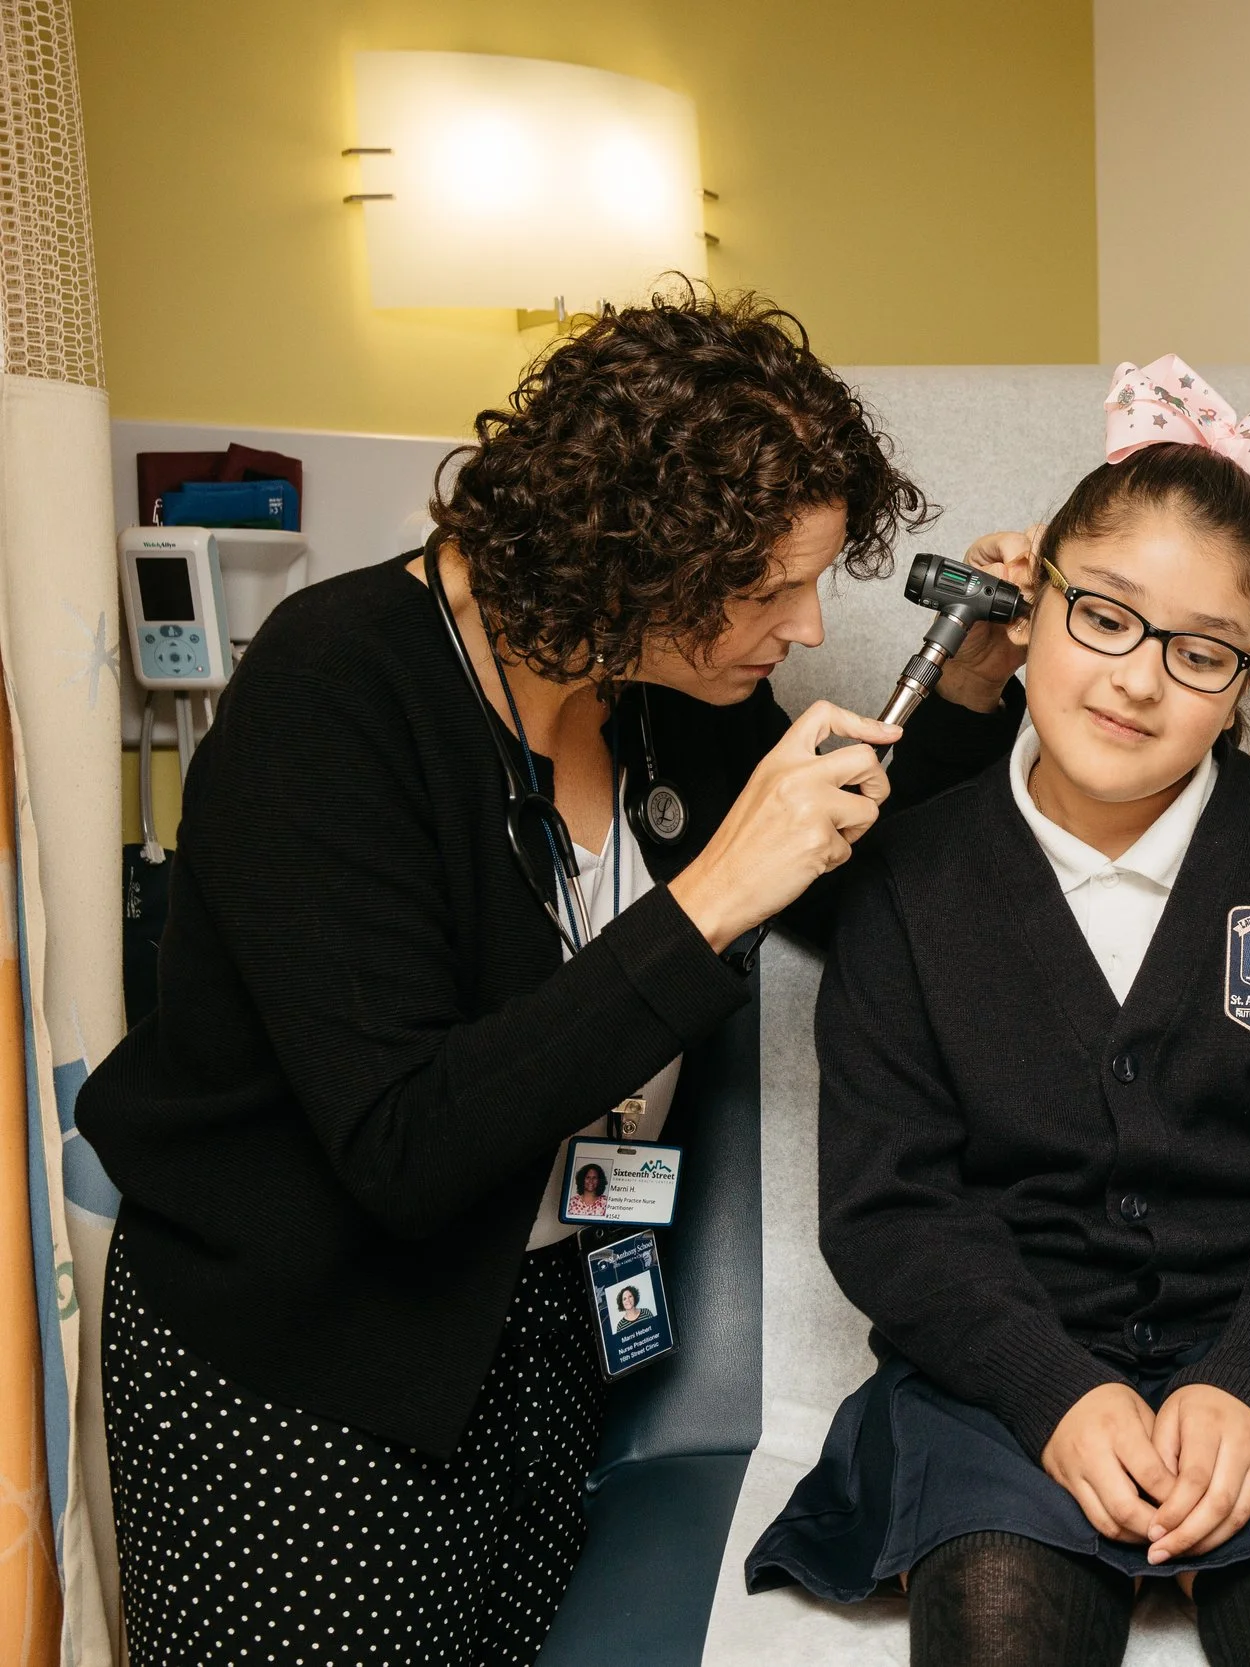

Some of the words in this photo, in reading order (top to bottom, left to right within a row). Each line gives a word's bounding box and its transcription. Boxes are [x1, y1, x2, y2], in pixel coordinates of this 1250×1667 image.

[1230, 995, 1243, 1005] St.
[613, 1168, 649, 1178] Sixteenth
[652, 1171, 675, 1180] Street
